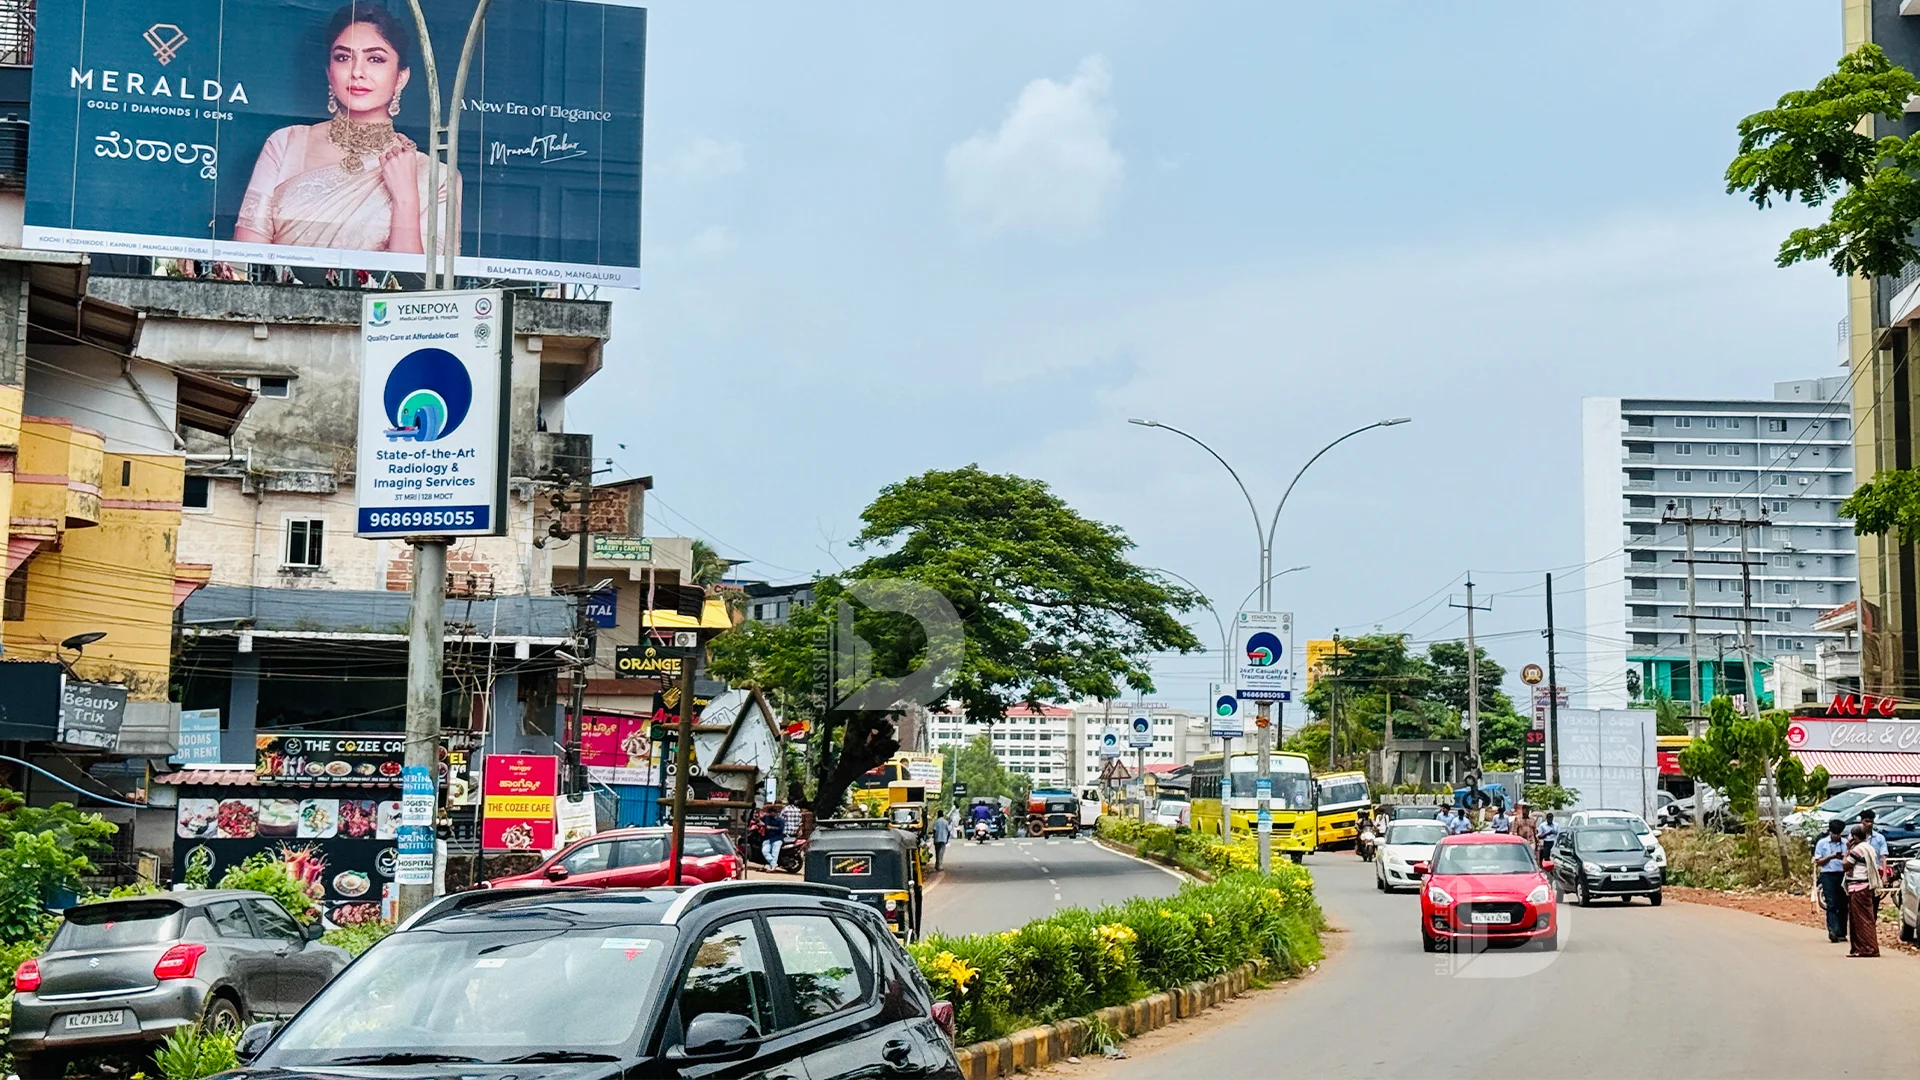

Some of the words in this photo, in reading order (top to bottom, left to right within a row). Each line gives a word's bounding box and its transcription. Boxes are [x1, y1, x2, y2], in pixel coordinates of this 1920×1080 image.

[70, 66, 249, 105] MERALDA
[87, 100, 119, 111] GOLD
[131, 104, 191, 117] DIAMONDS
[202, 109, 234, 121] GEMS
[471, 99, 504, 113] New
[506, 102, 529, 116] Era
[531, 103, 546, 117] of
[550, 105, 612, 123] Elegance
[39, 235, 61, 243] KOCHI
[66, 238, 104, 247] KOZHIKODE
[109, 241, 138, 249] KANNUR
[142, 243, 184, 252] MANGALURU
[187, 246, 208, 254] DUBAI
[487, 265, 533, 276] BALMATTA
[535, 268, 563, 279] ROAD,
[565, 270, 621, 281] MANGALURU
[397, 302, 459, 315] YENEPOYA
[367, 334, 389, 342] Quality
[412, 332, 445, 341] Affordable
[376, 447, 475, 461] State-of-the-Art
[388, 462, 448, 476] Radiology
[451, 462, 459, 473] &
[373, 477, 422, 490] Imaging
[425, 476, 476, 487] Services
[394, 493, 403, 501] 3T
[403, 493, 418, 501] MRI
[421, 493, 432, 501] 128
[433, 492, 454, 500] MDCT
[370, 511, 475, 527] 9686985055
[585, 604, 613, 616] ITAL
[618, 657, 682, 671] ORANGE
[63, 692, 119, 711] Beauty
[1825, 693, 1897, 716] MFC
[73, 707, 105, 723] Trix
[178, 733, 212, 746] ROOMS
[1829, 723, 1876, 748] Chai
[1879, 725, 1895, 745] &
[172, 747, 191, 760] OR
[193, 746, 218, 758] RENT
[304, 739, 331, 752] THE
[336, 740, 381, 753] COZEE
[508, 764, 533, 772] Hangyo
[487, 802, 503, 812] THE
[504, 802, 530, 812] COZEE
[531, 803, 551, 812] CAFE
[398, 832, 435, 843] SPRINGS
